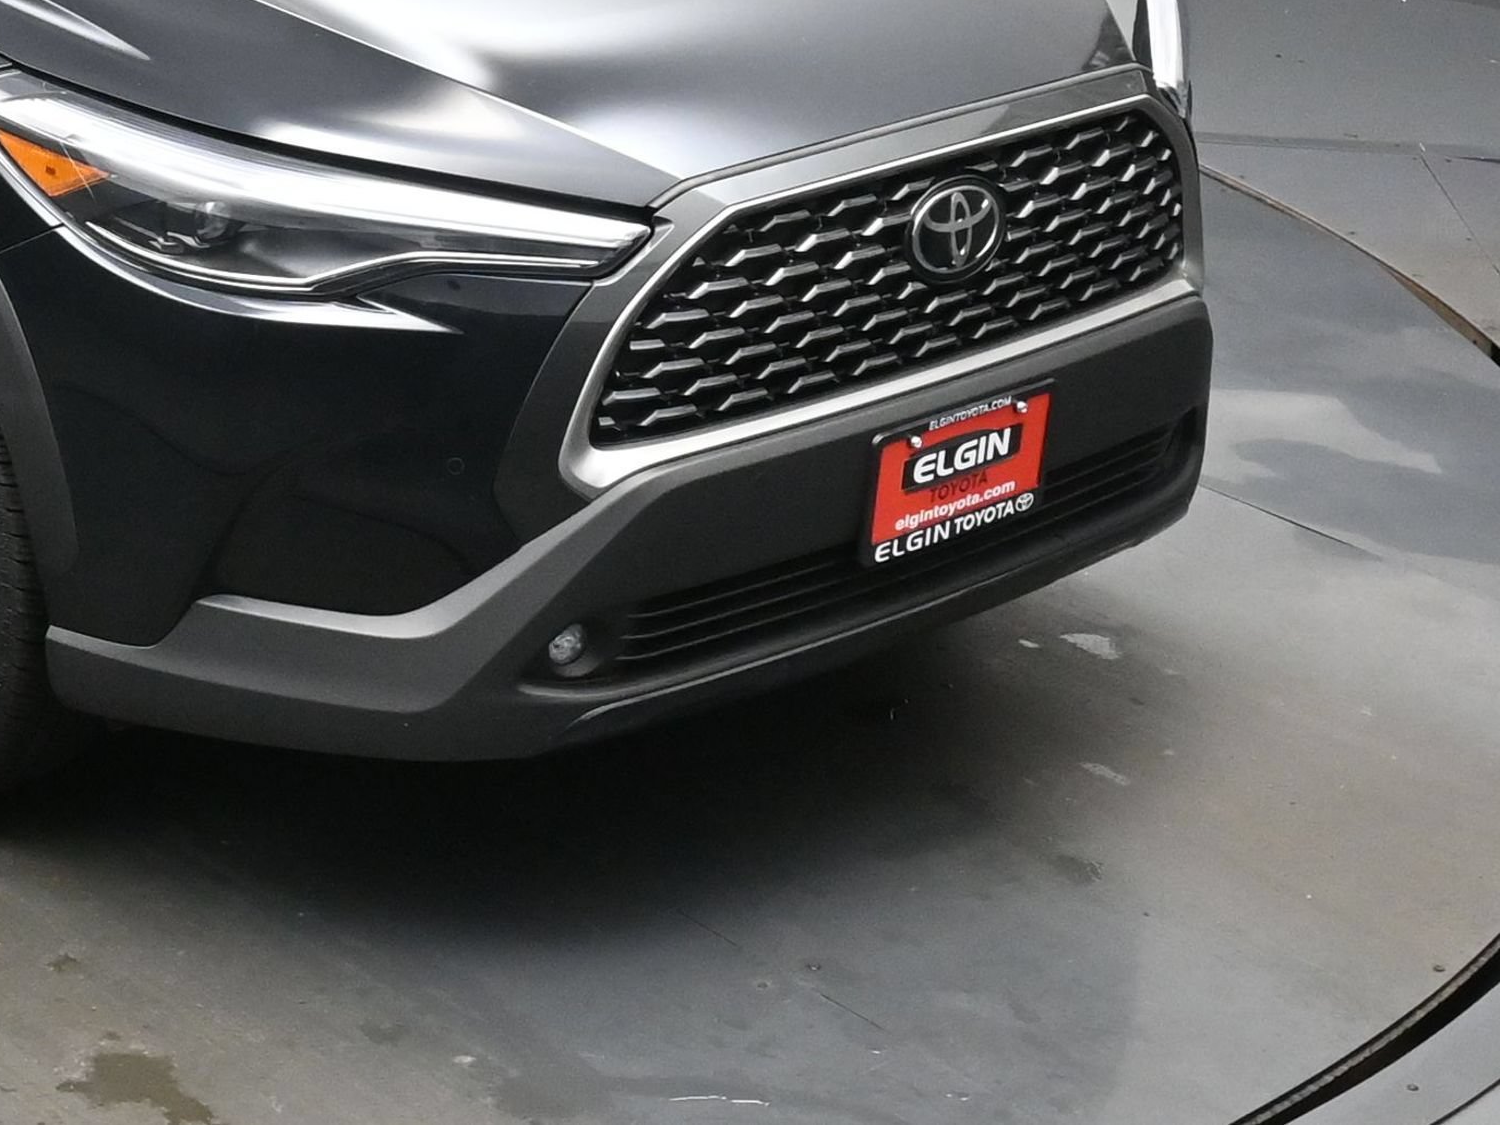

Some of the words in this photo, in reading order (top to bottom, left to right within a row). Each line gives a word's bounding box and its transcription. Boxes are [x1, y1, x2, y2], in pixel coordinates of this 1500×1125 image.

[929, 396, 1012, 431] ELGINTOYOTA.COM
[913, 428, 1011, 484] ELGIN
[895, 480, 1015, 531] elgintoyota.com
[930, 471, 988, 502] TOYOTA
[874, 521, 950, 563] ELGIN
[954, 500, 1015, 535] TOYOTA
